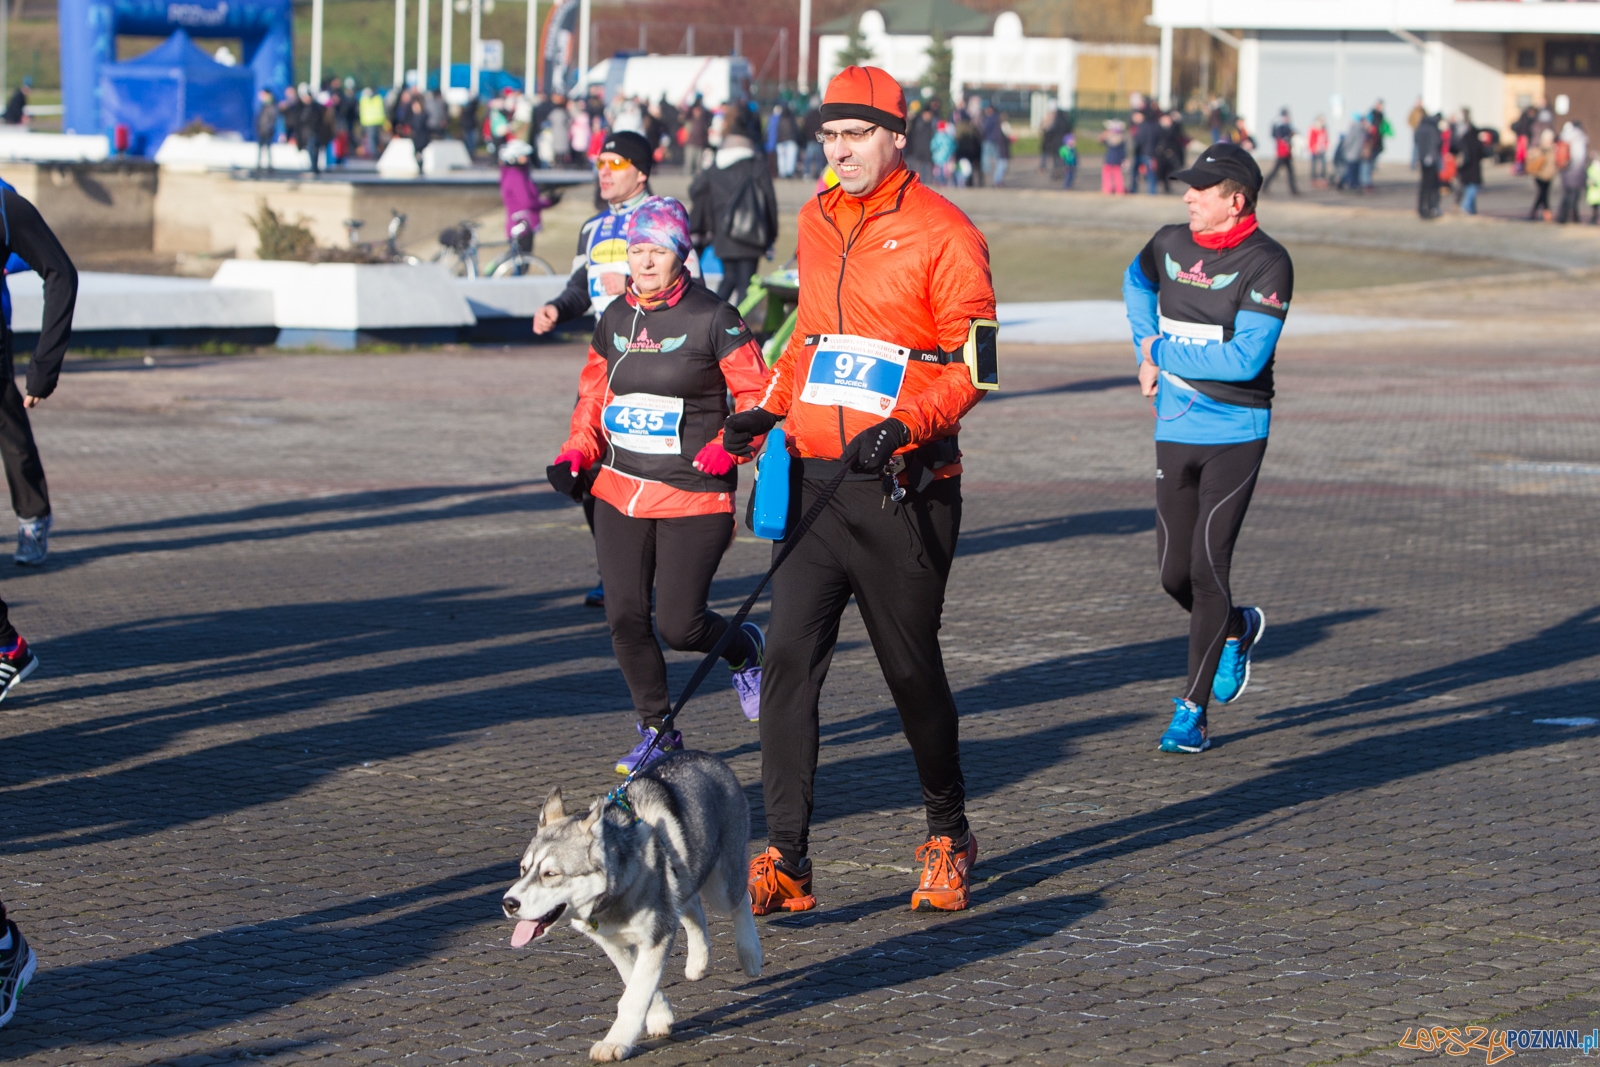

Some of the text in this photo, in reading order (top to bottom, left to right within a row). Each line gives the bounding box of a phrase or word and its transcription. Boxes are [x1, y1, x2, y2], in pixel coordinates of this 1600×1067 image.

[833, 353, 877, 380] 97
[834, 378, 868, 389] WOJCIECH
[615, 407, 665, 431] 435
[628, 428, 650, 436] DANUTA
